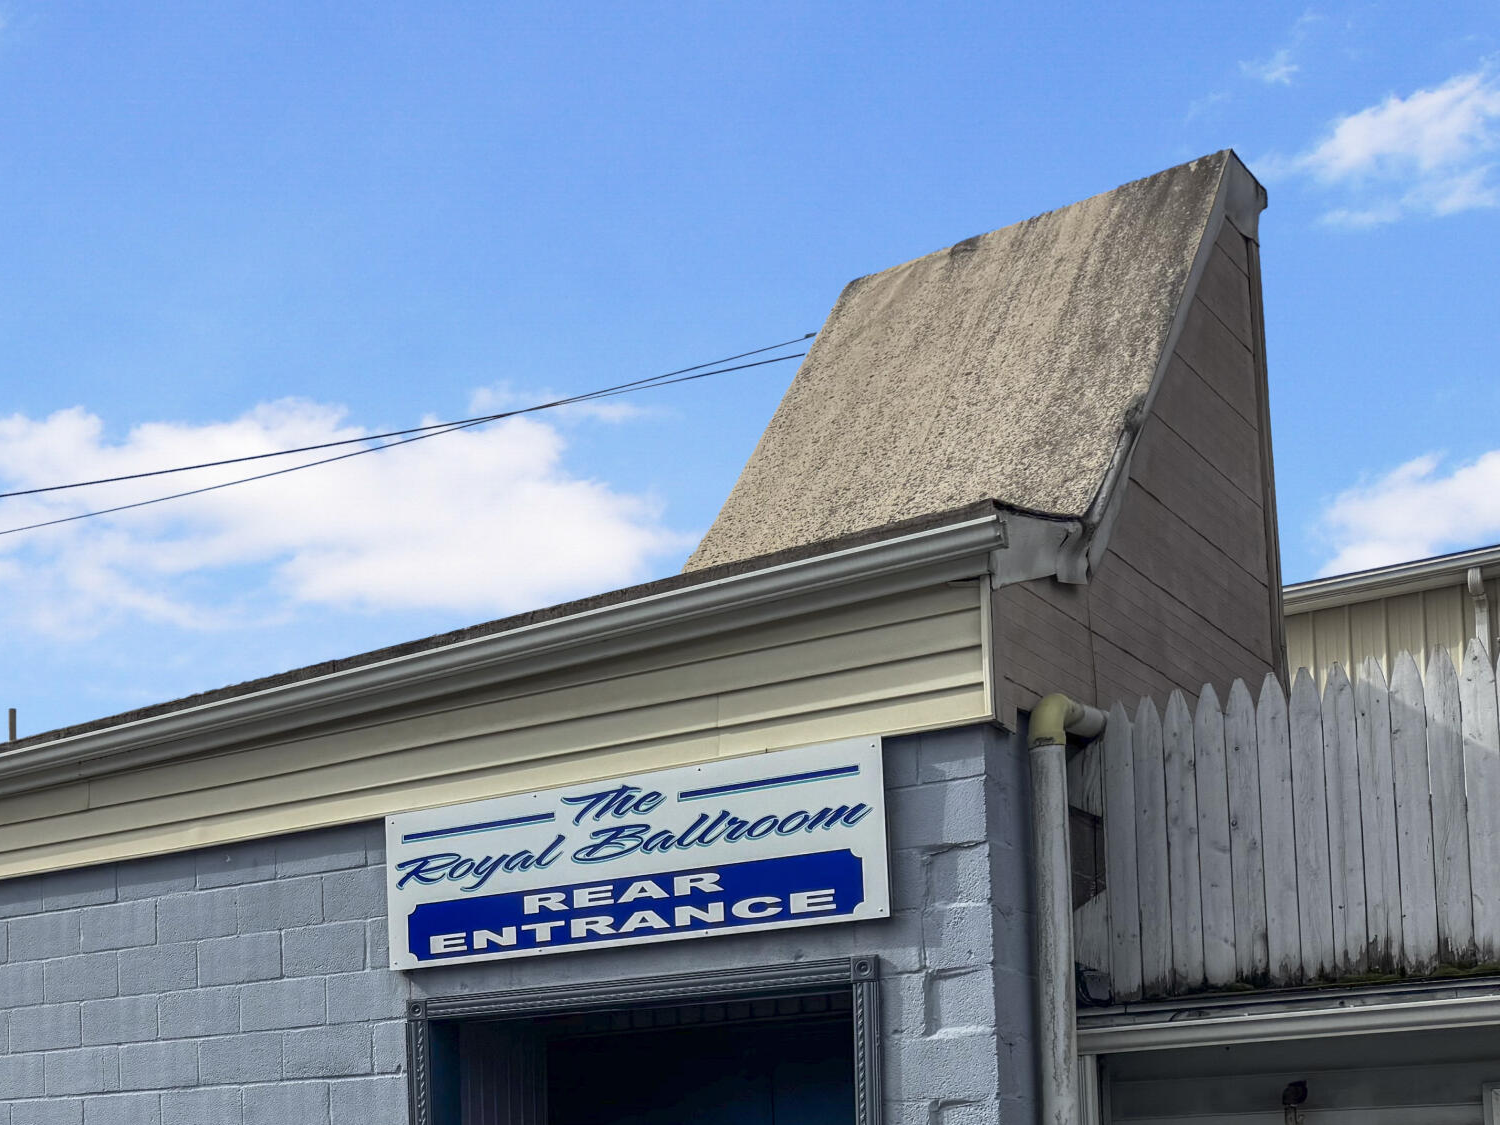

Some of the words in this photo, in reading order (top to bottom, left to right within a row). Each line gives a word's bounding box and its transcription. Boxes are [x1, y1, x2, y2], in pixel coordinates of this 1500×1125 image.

[561, 785, 666, 825] The
[396, 834, 565, 891] Royal
[571, 803, 873, 864] Ballroom
[523, 872, 725, 915] REAR
[429, 888, 837, 955] ENTRANCE
